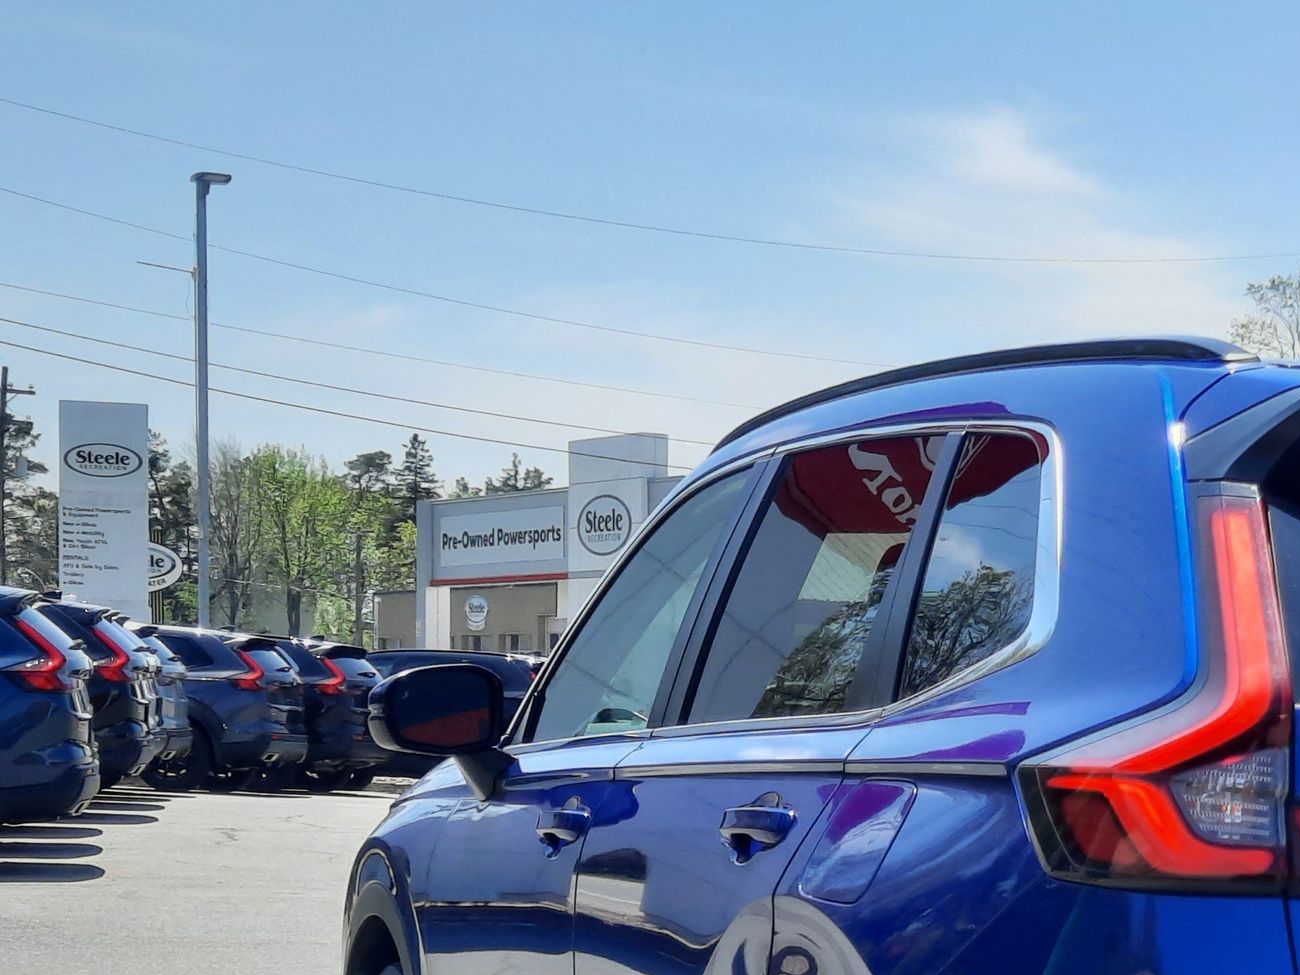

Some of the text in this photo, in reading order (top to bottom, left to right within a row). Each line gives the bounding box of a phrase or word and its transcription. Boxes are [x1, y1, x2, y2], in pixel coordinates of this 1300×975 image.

[75, 450, 131, 465] Steele
[585, 508, 623, 534] Steele
[442, 525, 562, 550] Pre-Owned Powersports
